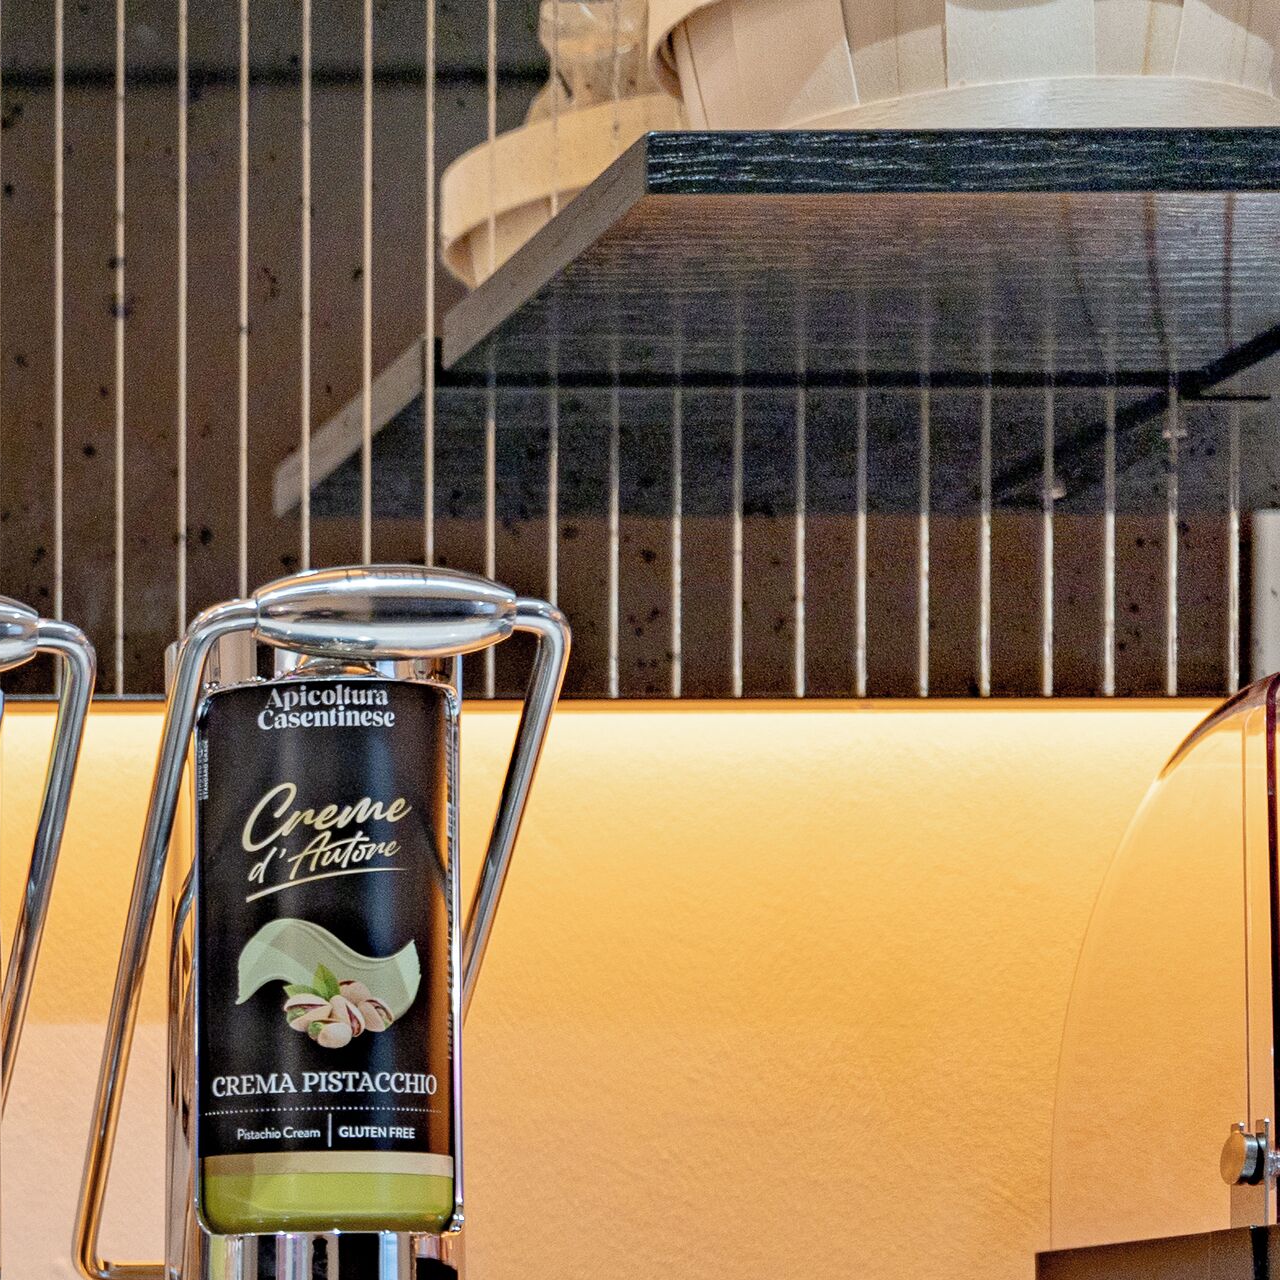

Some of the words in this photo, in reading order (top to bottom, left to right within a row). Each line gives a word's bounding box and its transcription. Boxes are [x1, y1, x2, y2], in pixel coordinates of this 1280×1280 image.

[266, 685, 388, 710] Apicoltura
[257, 705, 396, 731] Casentinese
[241, 782, 412, 853] Creme
[211, 1072, 295, 1097] CREMA
[302, 1071, 438, 1096] PISTACCHIO
[236, 1126, 281, 1141] Pistachio
[283, 1126, 321, 1140] Cream
[338, 1126, 388, 1139] GLUTEN
[389, 1126, 416, 1139] FREE
